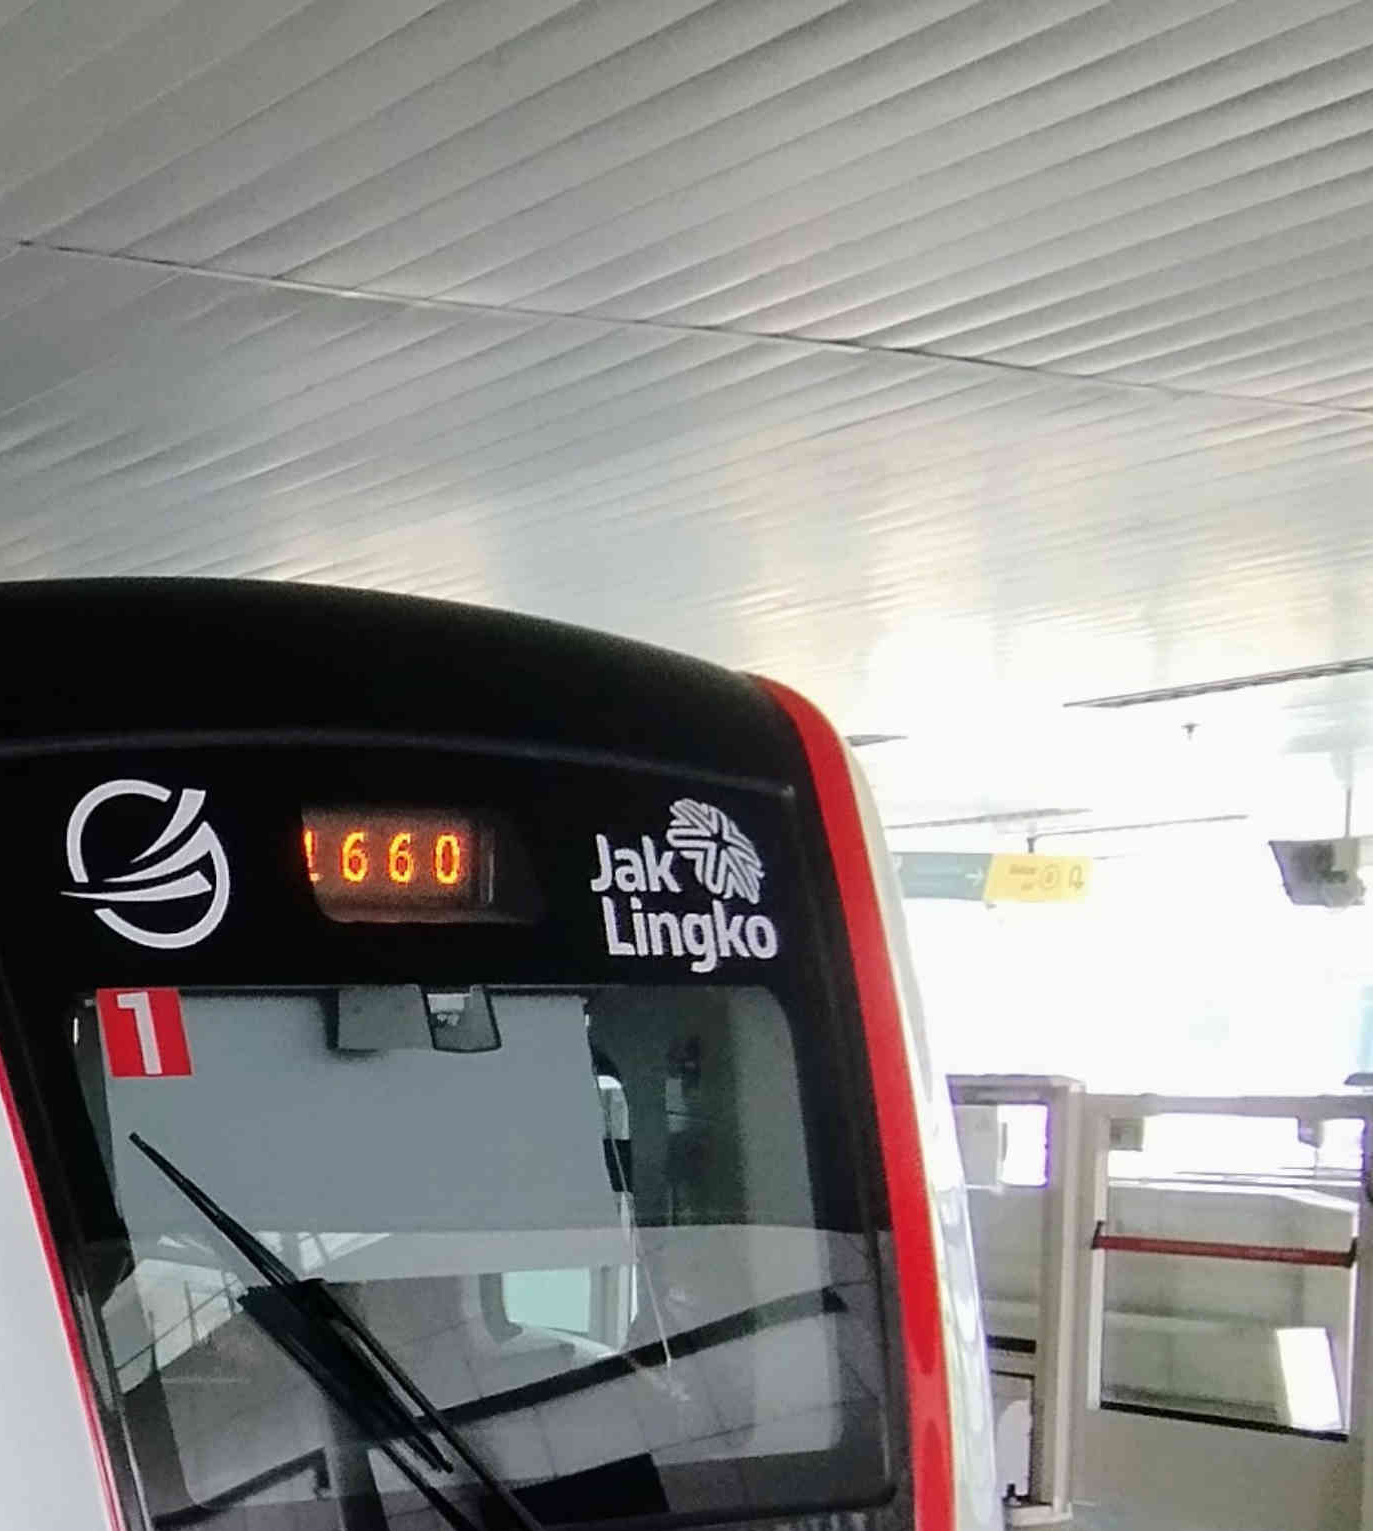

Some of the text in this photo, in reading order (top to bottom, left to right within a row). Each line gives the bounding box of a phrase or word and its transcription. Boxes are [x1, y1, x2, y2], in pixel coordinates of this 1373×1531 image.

[591, 833, 683, 893] Jak
[602, 896, 779, 974] Lingko
[116, 991, 163, 1075] 1
